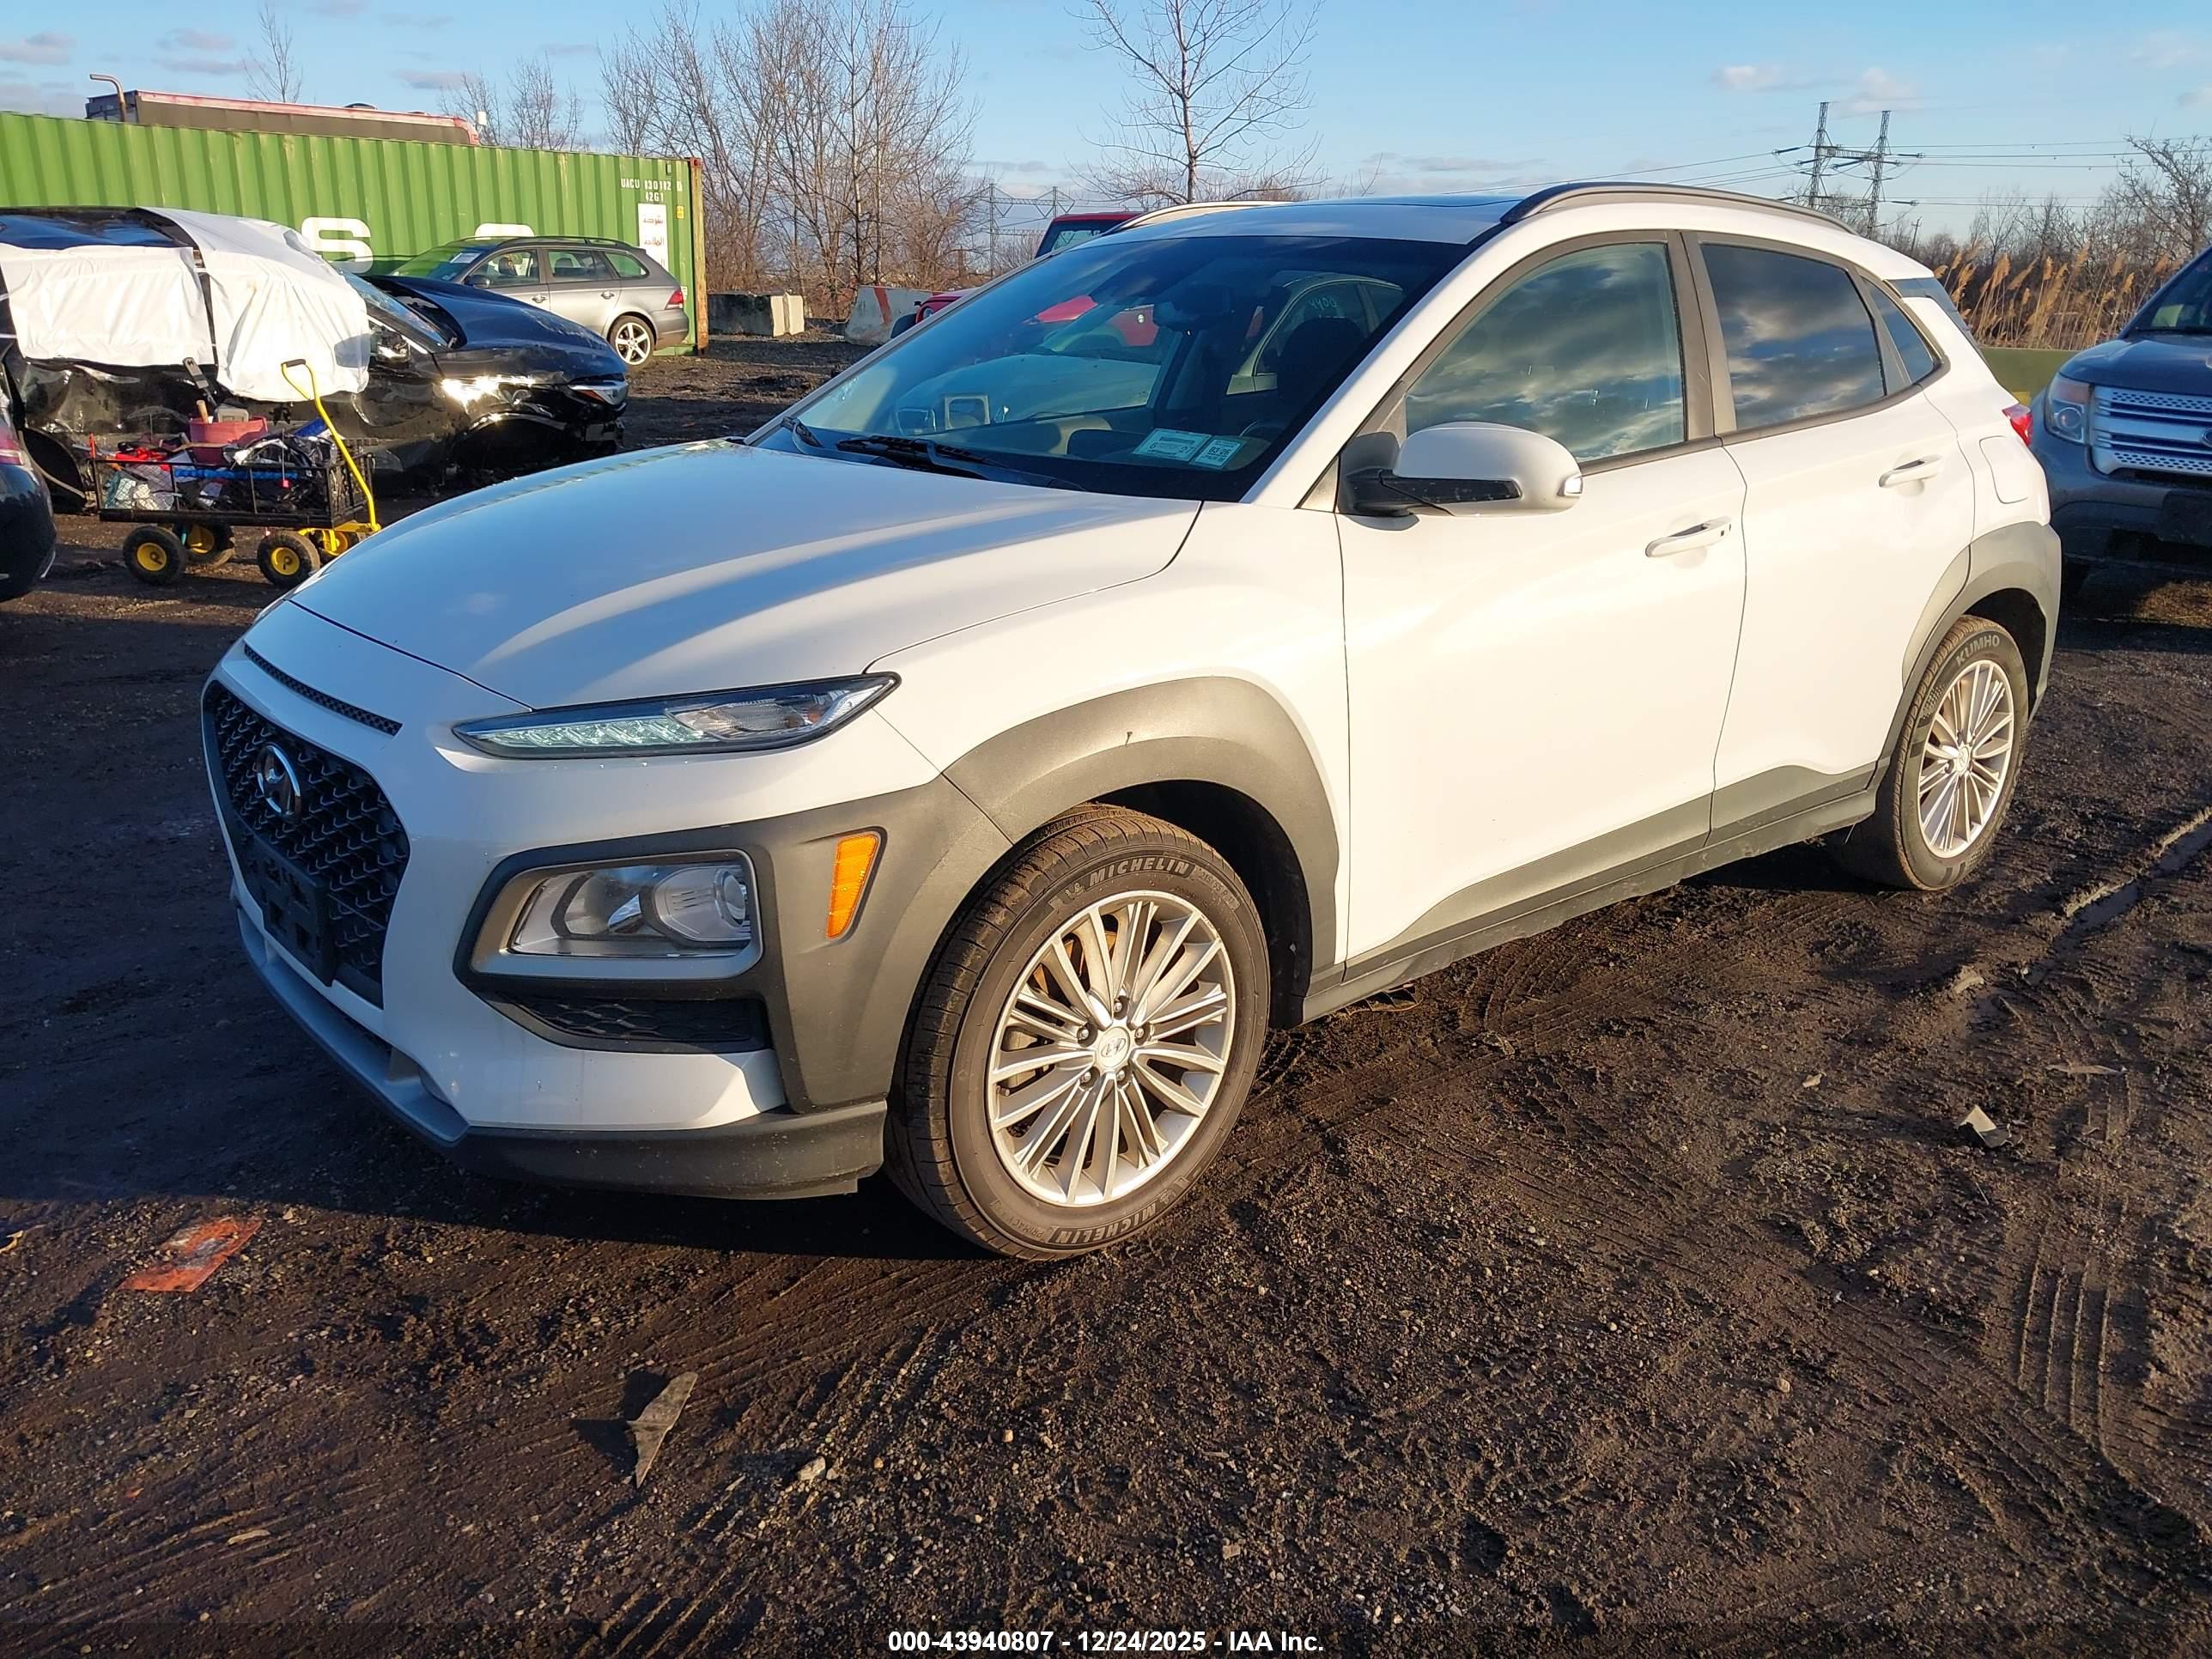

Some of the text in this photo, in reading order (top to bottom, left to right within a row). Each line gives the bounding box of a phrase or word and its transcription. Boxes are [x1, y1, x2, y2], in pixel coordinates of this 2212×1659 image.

[621, 178, 640, 189] UACU
[1956, 635, 2000, 666] KUMHO
[1089, 857, 1189, 886] MICHELIN
[1055, 1202, 1157, 1244] MICHELIN
